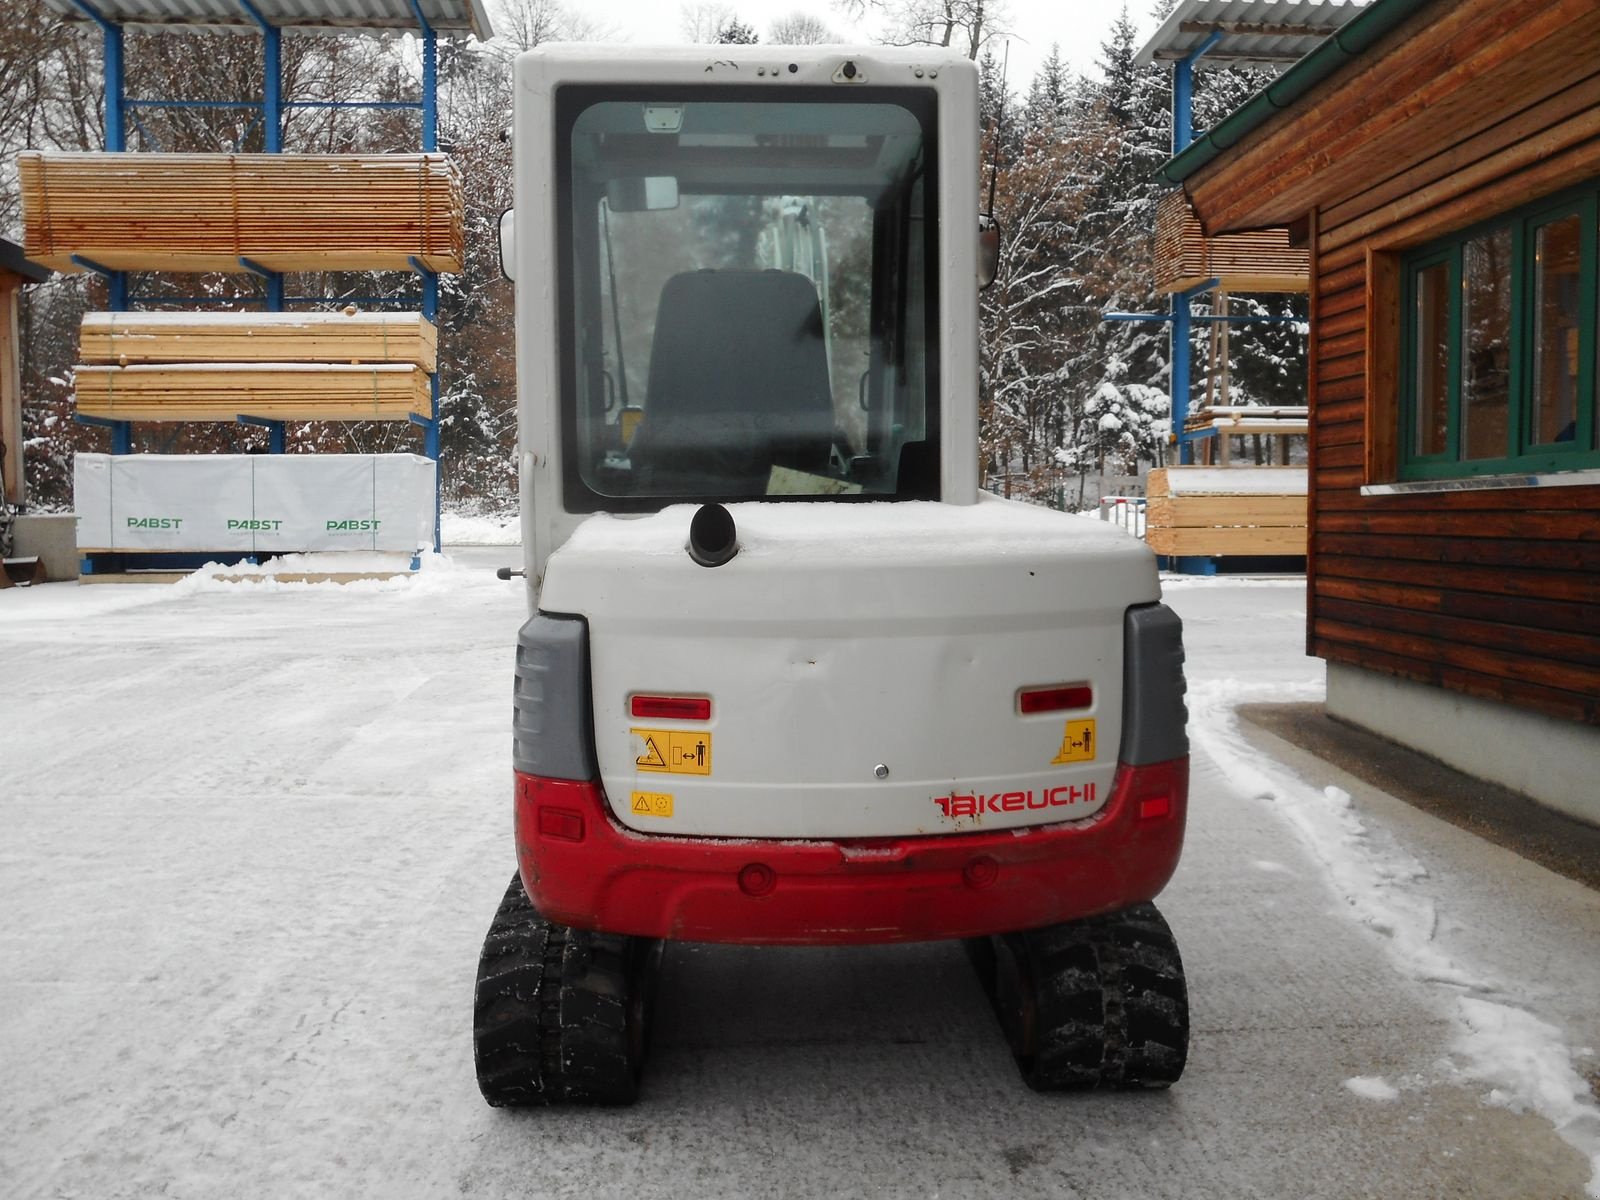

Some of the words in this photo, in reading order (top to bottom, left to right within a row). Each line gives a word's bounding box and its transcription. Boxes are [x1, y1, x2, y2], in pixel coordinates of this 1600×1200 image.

[127, 517, 183, 529] PABST
[227, 519, 283, 530] PABST
[326, 519, 382, 531] PABST
[934, 782, 1096, 817] TAKEUCHI
